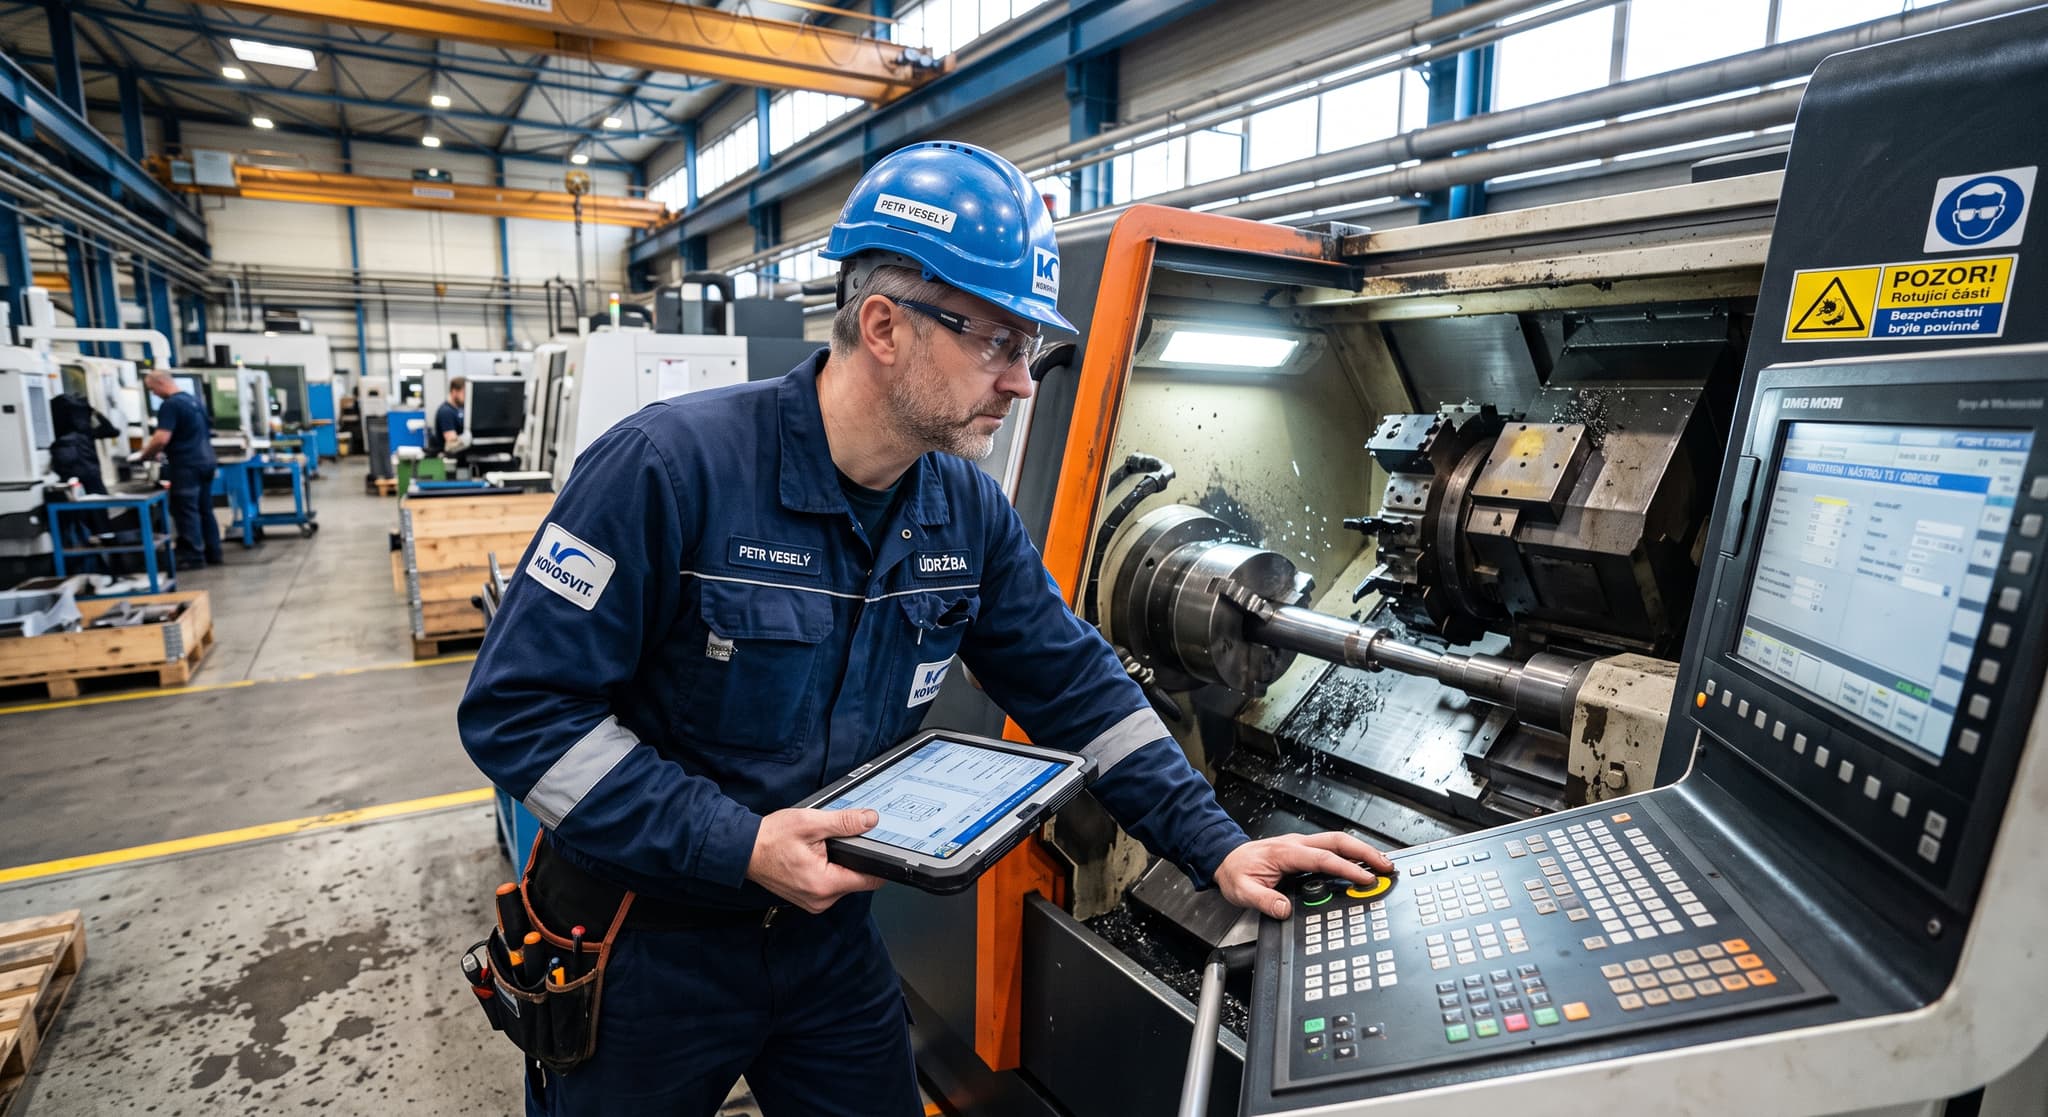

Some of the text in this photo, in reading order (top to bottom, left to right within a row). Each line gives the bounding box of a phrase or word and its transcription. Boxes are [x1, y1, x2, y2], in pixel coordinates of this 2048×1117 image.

[880, 200, 949, 225] PETR VESELÝ
[1893, 265, 1997, 288] POZOR!
[1891, 286, 1991, 304] Rotující části
[1890, 305, 1985, 322] Bezpečnostní
[1888, 319, 1980, 336] brýle povinné
[1782, 396, 1844, 409] DMG MORI
[739, 545, 812, 567] PETR VESELÝ
[919, 554, 968, 572] ÚDRŽBA
